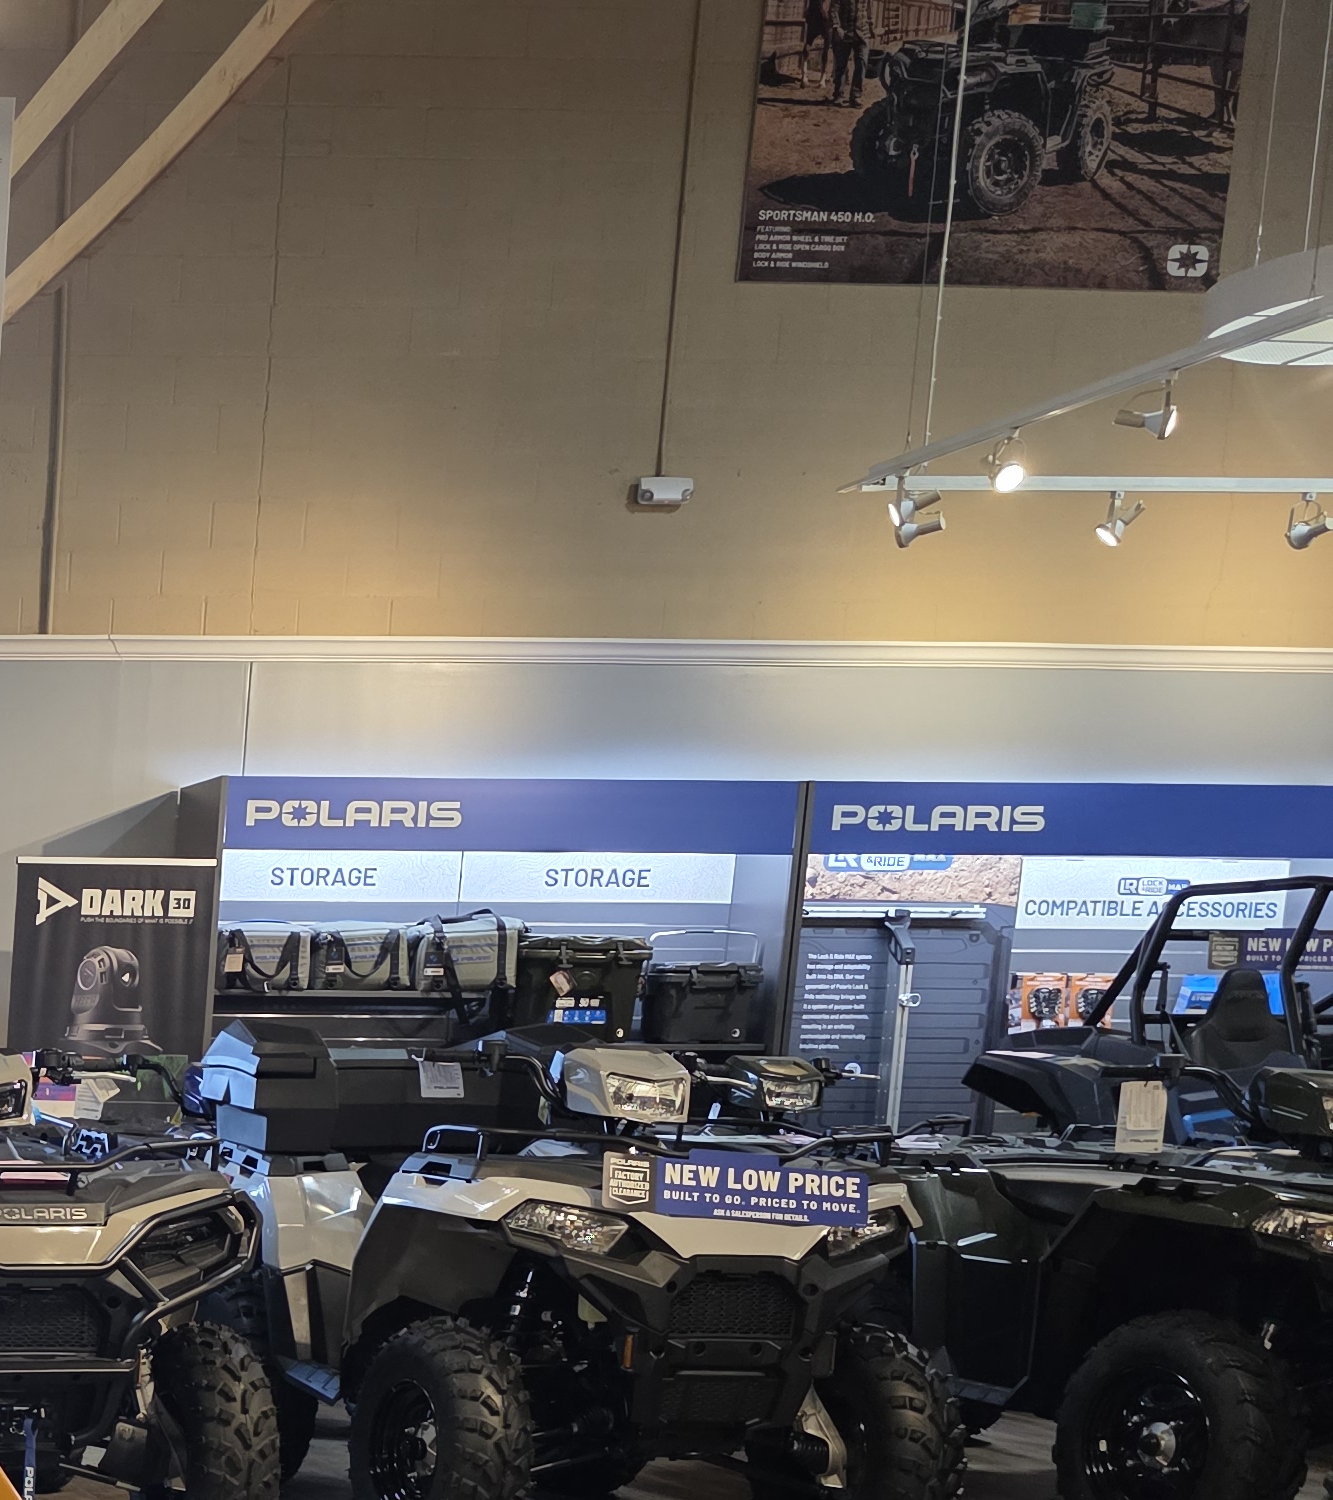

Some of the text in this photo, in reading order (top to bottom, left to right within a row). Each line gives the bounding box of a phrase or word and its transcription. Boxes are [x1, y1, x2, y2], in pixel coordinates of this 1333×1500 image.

[758, 210, 876, 223] SPORTSMAN 450 H.O.
[245, 800, 462, 828] POLARIS
[831, 804, 1045, 832] POLARIS
[270, 866, 377, 888] STORAGE
[544, 867, 651, 889] STORAGE
[81, 889, 165, 917] DARK
[1024, 900, 1144, 917] COMPATIBLE
[1247, 937, 1282, 951] NEW
[610, 1157, 650, 1168] POLARIS
[609, 1178, 650, 1190] AUTHORIZED
[615, 1170, 645, 1181] FACTORY
[664, 1162, 861, 1199] NEW LOW PRICE
[613, 1187, 646, 1198] CLEARANCE
[663, 1190, 700, 1203] BUILT
[704, 1192, 720, 1203] TO
[750, 1197, 797, 1210] PRICED
[801, 1200, 818, 1211] TO
[822, 1202, 861, 1214] MOVE.
